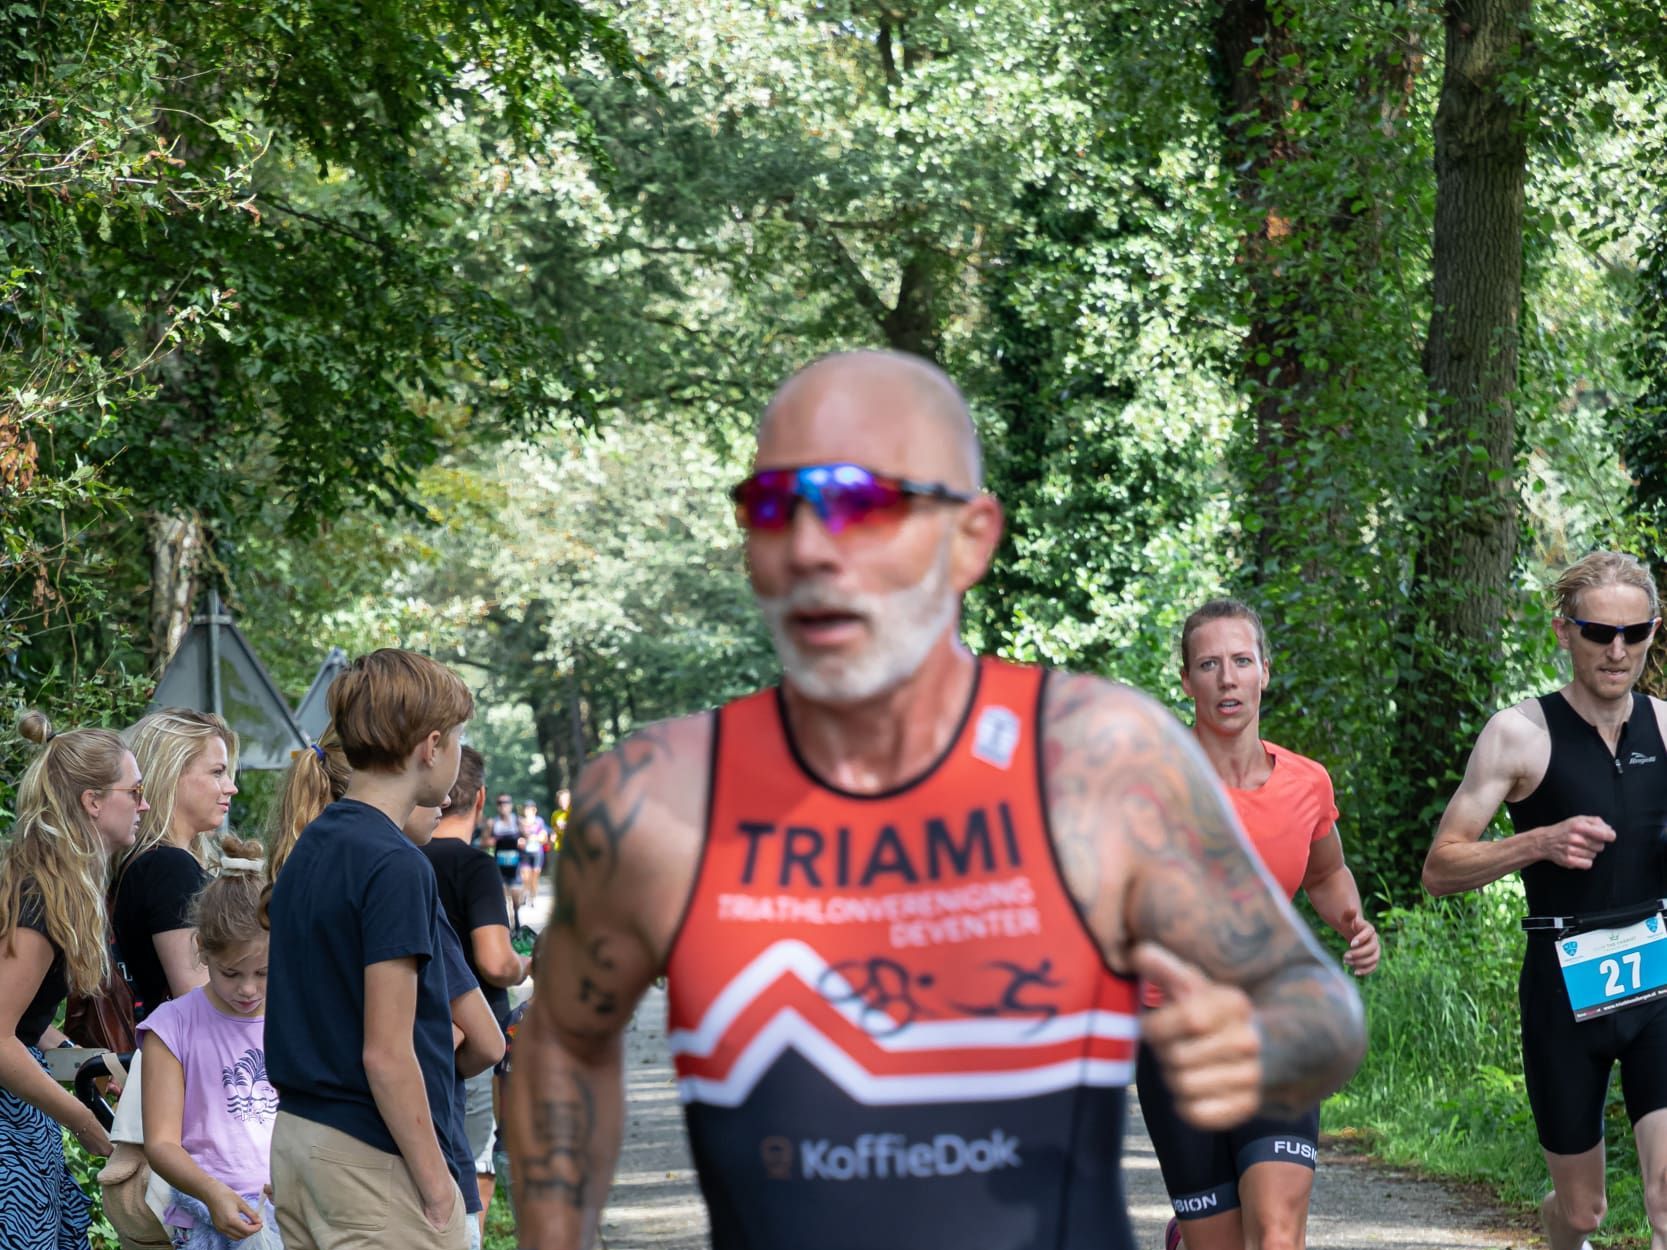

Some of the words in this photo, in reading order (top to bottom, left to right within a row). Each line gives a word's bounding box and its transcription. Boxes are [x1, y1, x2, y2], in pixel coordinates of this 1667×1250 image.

[737, 800, 1022, 888] TRIAMI
[889, 906, 1041, 949] DEVENTER
[1599, 951, 1642, 997] 27
[800, 1129, 1022, 1181] KoffieDok
